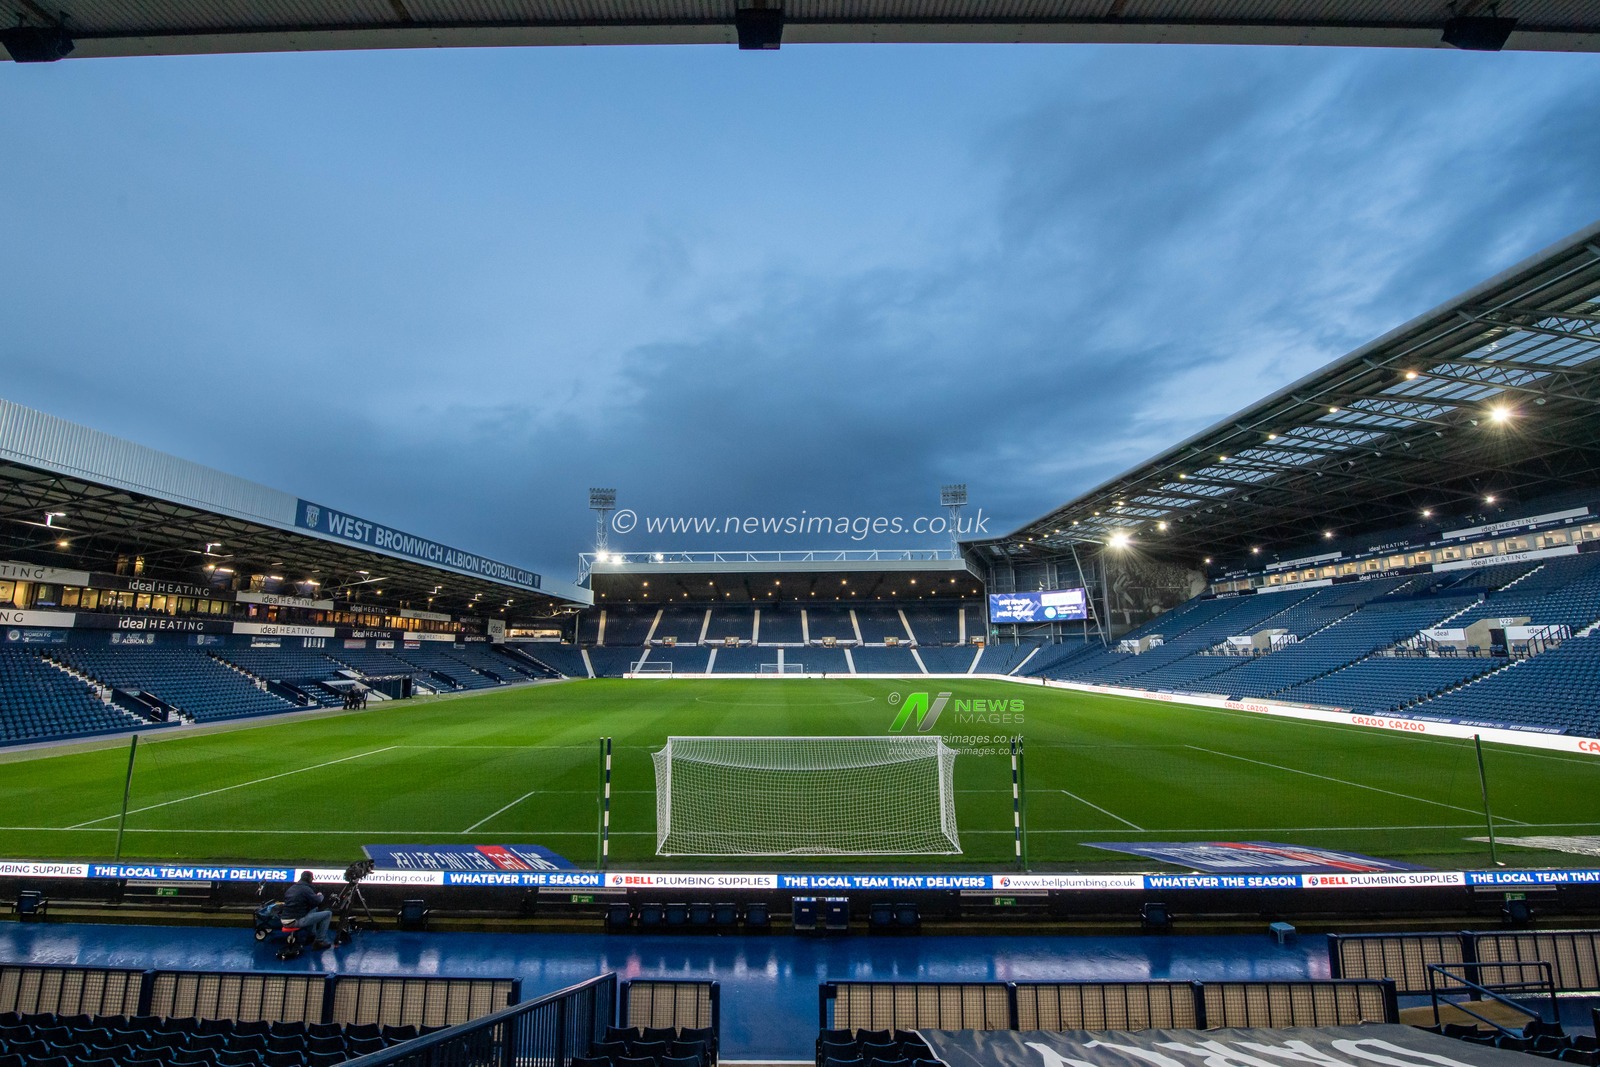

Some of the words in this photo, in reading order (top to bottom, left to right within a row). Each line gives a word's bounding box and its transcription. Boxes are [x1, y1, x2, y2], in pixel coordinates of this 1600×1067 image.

[1482, 524, 1498, 532] ideal
[1500, 518, 1538, 528] HEATING
[328, 512, 372, 542] WEST
[375, 526, 444, 562] BROMWICH
[444, 549, 480, 572] ALBION
[480, 560, 516, 581] FOOTBALL
[518, 570, 532, 585] CLUB
[1381, 540, 1410, 550] HEATING
[1470, 558, 1488, 566] ideal
[1488, 553, 1528, 563] HEATING
[0, 565, 44, 580] TING
[1372, 570, 1400, 578] HEATING
[128, 579, 156, 592] ideal
[158, 583, 210, 596] HEATING
[262, 594, 280, 604] ideal
[280, 598, 315, 607] HEATING
[364, 606, 388, 614] HEATING
[118, 616, 147, 629] ideal
[150, 620, 204, 631] HEATING
[260, 624, 278, 634] ideal
[280, 626, 316, 635] HEATING
[1224, 702, 1244, 710] CAZOO
[1246, 704, 1268, 712] CAZOO
[1352, 716, 1384, 727] CAZOO
[1388, 720, 1426, 732] CAZOO
[32, 866, 82, 874] SUPPLIES
[94, 866, 118, 876] THE
[120, 868, 158, 876] LOCAL
[160, 868, 194, 878] TEAM
[196, 869, 228, 878] THAT
[230, 870, 288, 880] DELIVERS
[450, 874, 520, 884] WHATEVER
[522, 874, 546, 884] THE
[549, 875, 598, 885] SEASON
[656, 876, 715, 886] PLUMBING
[718, 878, 770, 886] SUPPLIES
[784, 877, 808, 886] THE
[811, 877, 851, 886] LOCAL
[854, 877, 888, 886] TEAM
[891, 878, 923, 887] THAT
[926, 878, 986, 887] DELIVERS
[1012, 877, 1136, 888] www.bellplumbing.co.uk
[1150, 876, 1219, 886] WHATEVER
[1222, 876, 1246, 886] THE
[1248, 876, 1296, 886] SEASON
[1320, 876, 1348, 884] BELL
[1350, 876, 1406, 884] PLUMBING
[1409, 874, 1459, 884] SUPPLIES
[1470, 874, 1493, 882] THE
[1496, 873, 1534, 882] LOCAL
[1537, 872, 1568, 882] TEAM
[1570, 872, 1600, 882] THAT
